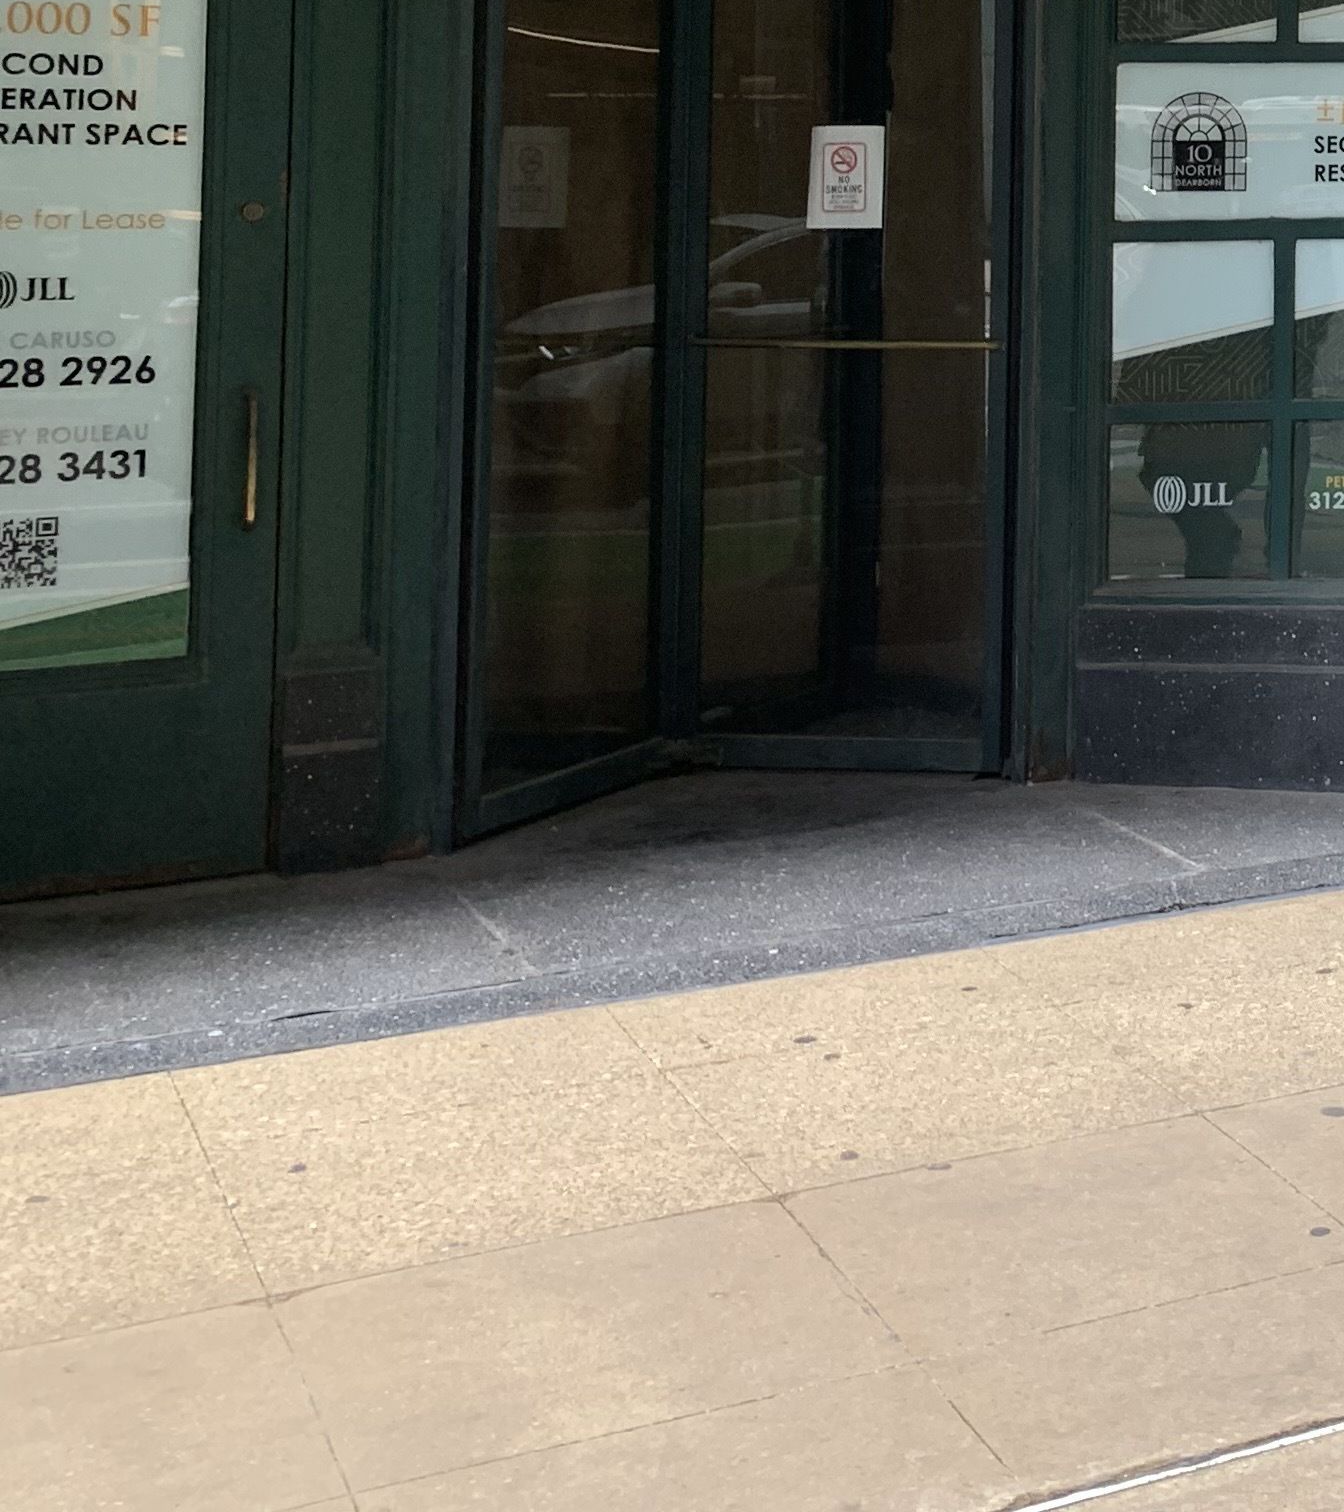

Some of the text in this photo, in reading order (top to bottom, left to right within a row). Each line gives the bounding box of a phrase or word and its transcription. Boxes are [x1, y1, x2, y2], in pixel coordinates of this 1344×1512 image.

[0, 0, 161, 37] 000 SF
[85, 123, 188, 146] SPACE
[1187, 144, 1213, 163] 10
[1175, 164, 1222, 176] NORTH
[33, 209, 72, 230] for
[82, 209, 166, 230] Lease
[20, 277, 75, 301] JLL
[10, 330, 116, 350] CARUSO
[59, 355, 156, 386] 2926
[37, 423, 149, 445] ROULEAU
[57, 449, 147, 482] 3431
[1188, 482, 1234, 506] JLL
[1309, 491, 1344, 509] 312
